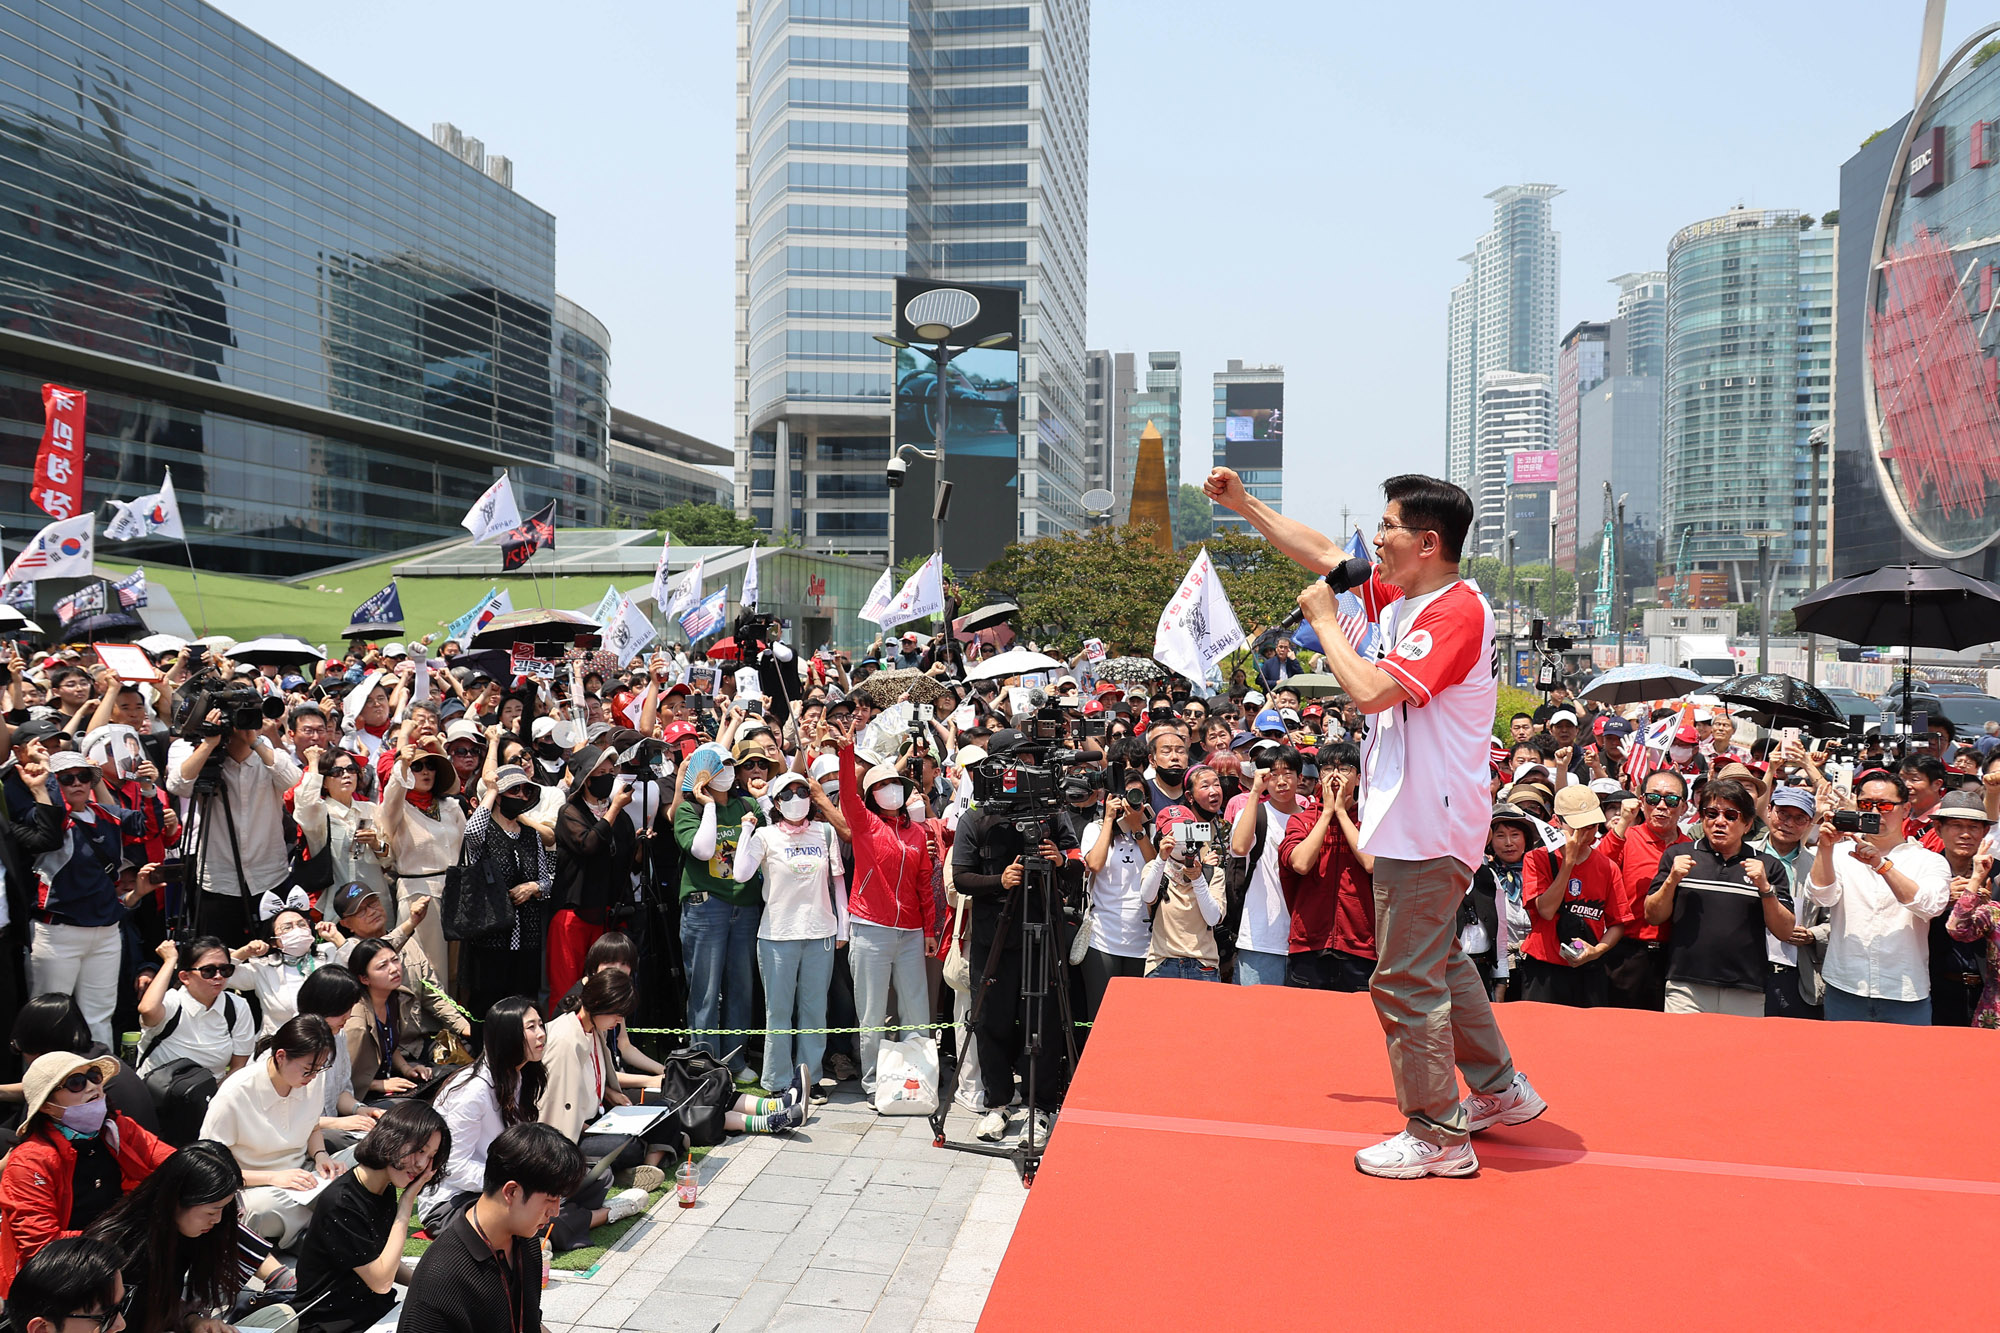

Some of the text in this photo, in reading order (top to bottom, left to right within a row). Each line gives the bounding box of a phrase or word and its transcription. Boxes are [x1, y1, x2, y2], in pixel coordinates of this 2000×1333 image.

[1910, 148, 1932, 176] HDC
[513, 660, 553, 675] 김문수
[785, 846, 822, 859] TREVISO
[1570, 904, 1604, 918] COREA!
